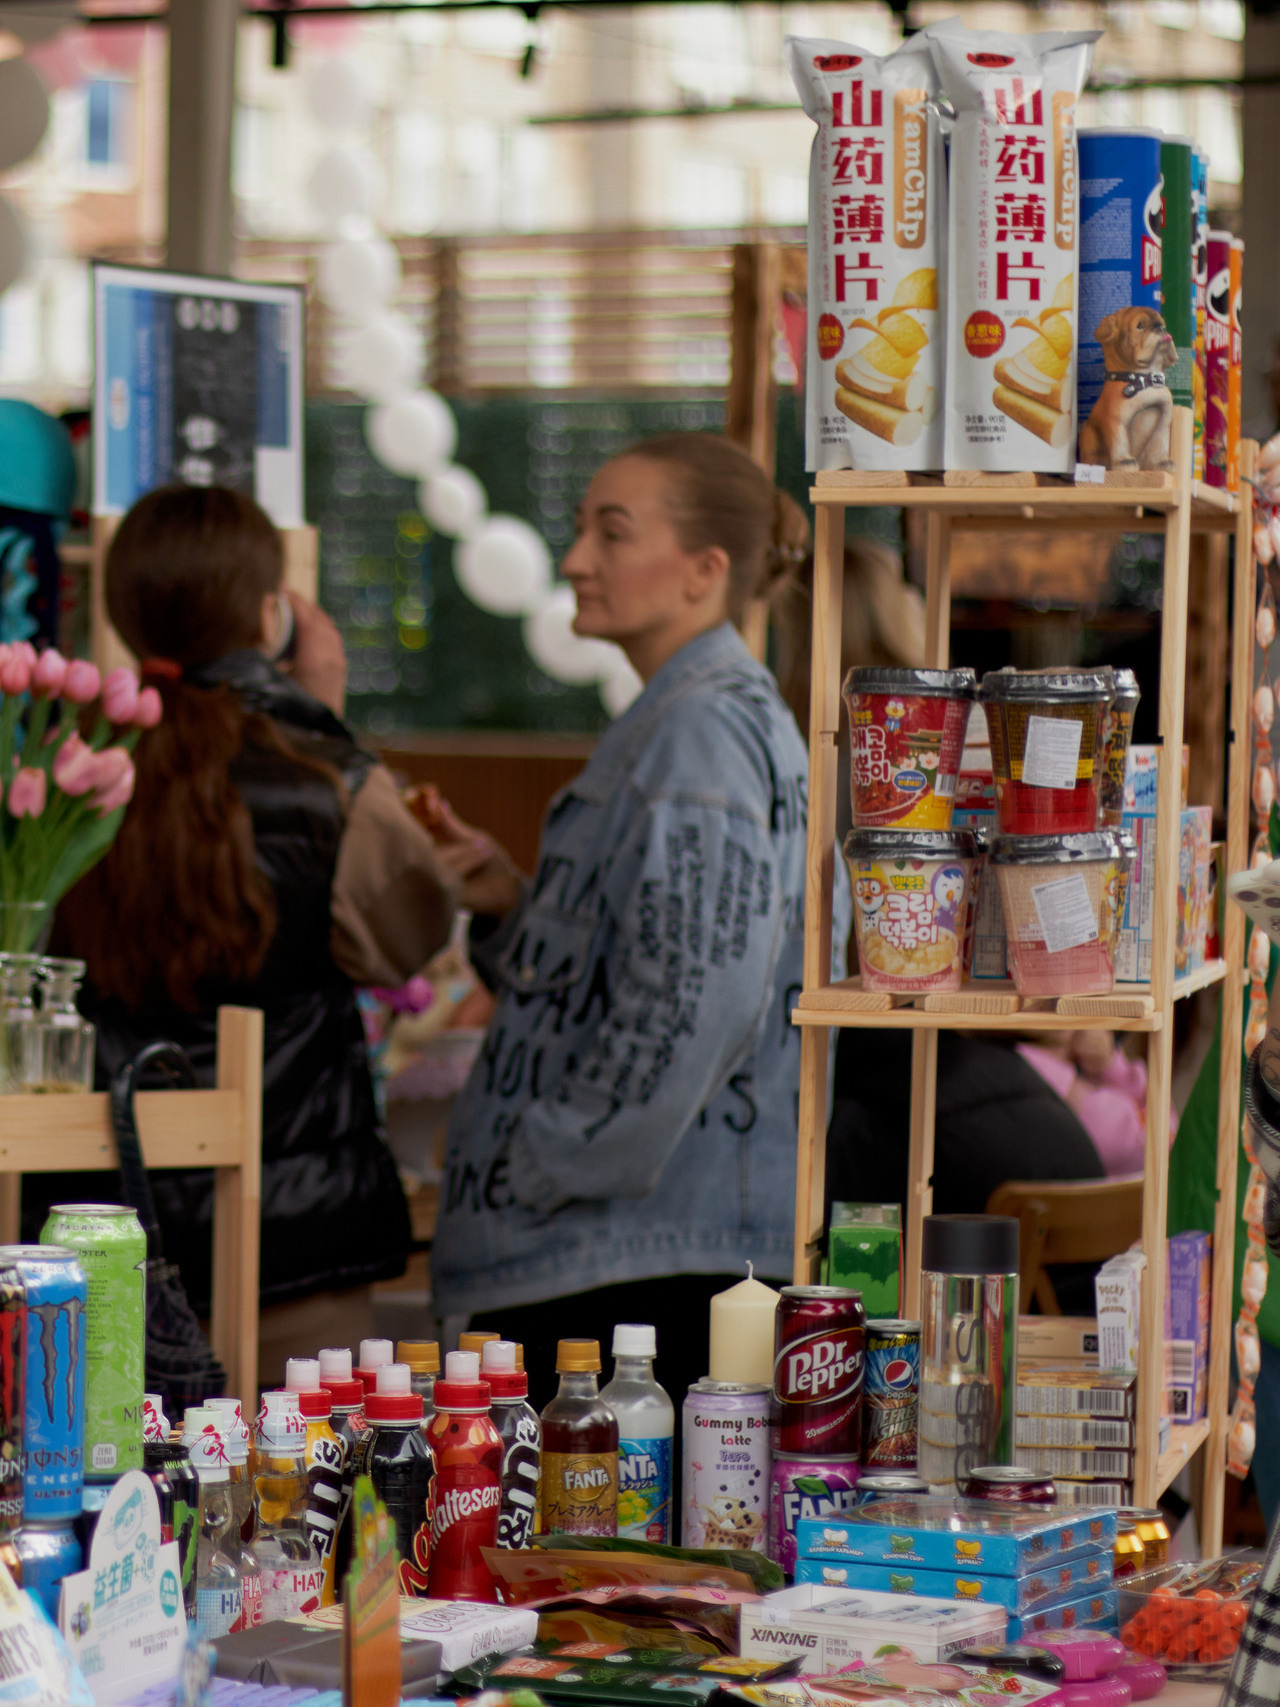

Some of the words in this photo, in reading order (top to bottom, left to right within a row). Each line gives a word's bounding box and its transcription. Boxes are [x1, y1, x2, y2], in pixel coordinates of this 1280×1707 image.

[896, 102, 927, 241] YamChip
[830, 80, 884, 302] 山药薄片
[993, 77, 1047, 301] 山药薄片
[878, 918, 939, 951] 떡볶이
[59, 1223, 113, 1232] TAURYNA
[31, 1263, 65, 1274] ZERO
[812, 1340, 848, 1370] Dr
[788, 1350, 863, 1395] Pepper
[694, 1415, 742, 1432] Gummy
[721, 1435, 752, 1446] Latte
[97, 1447, 113, 1455] ZERO
[720, 1450, 751, 1462] Taro
[95, 1456, 114, 1465] SUGAR
[564, 1468, 610, 1492] FANTA
[34, 1489, 72, 1498] ULTRA
[94, 1552, 136, 1611] 益生菌
[751, 1628, 819, 1648] XINXING
[826, 1637, 849, 1647] 白桃味
